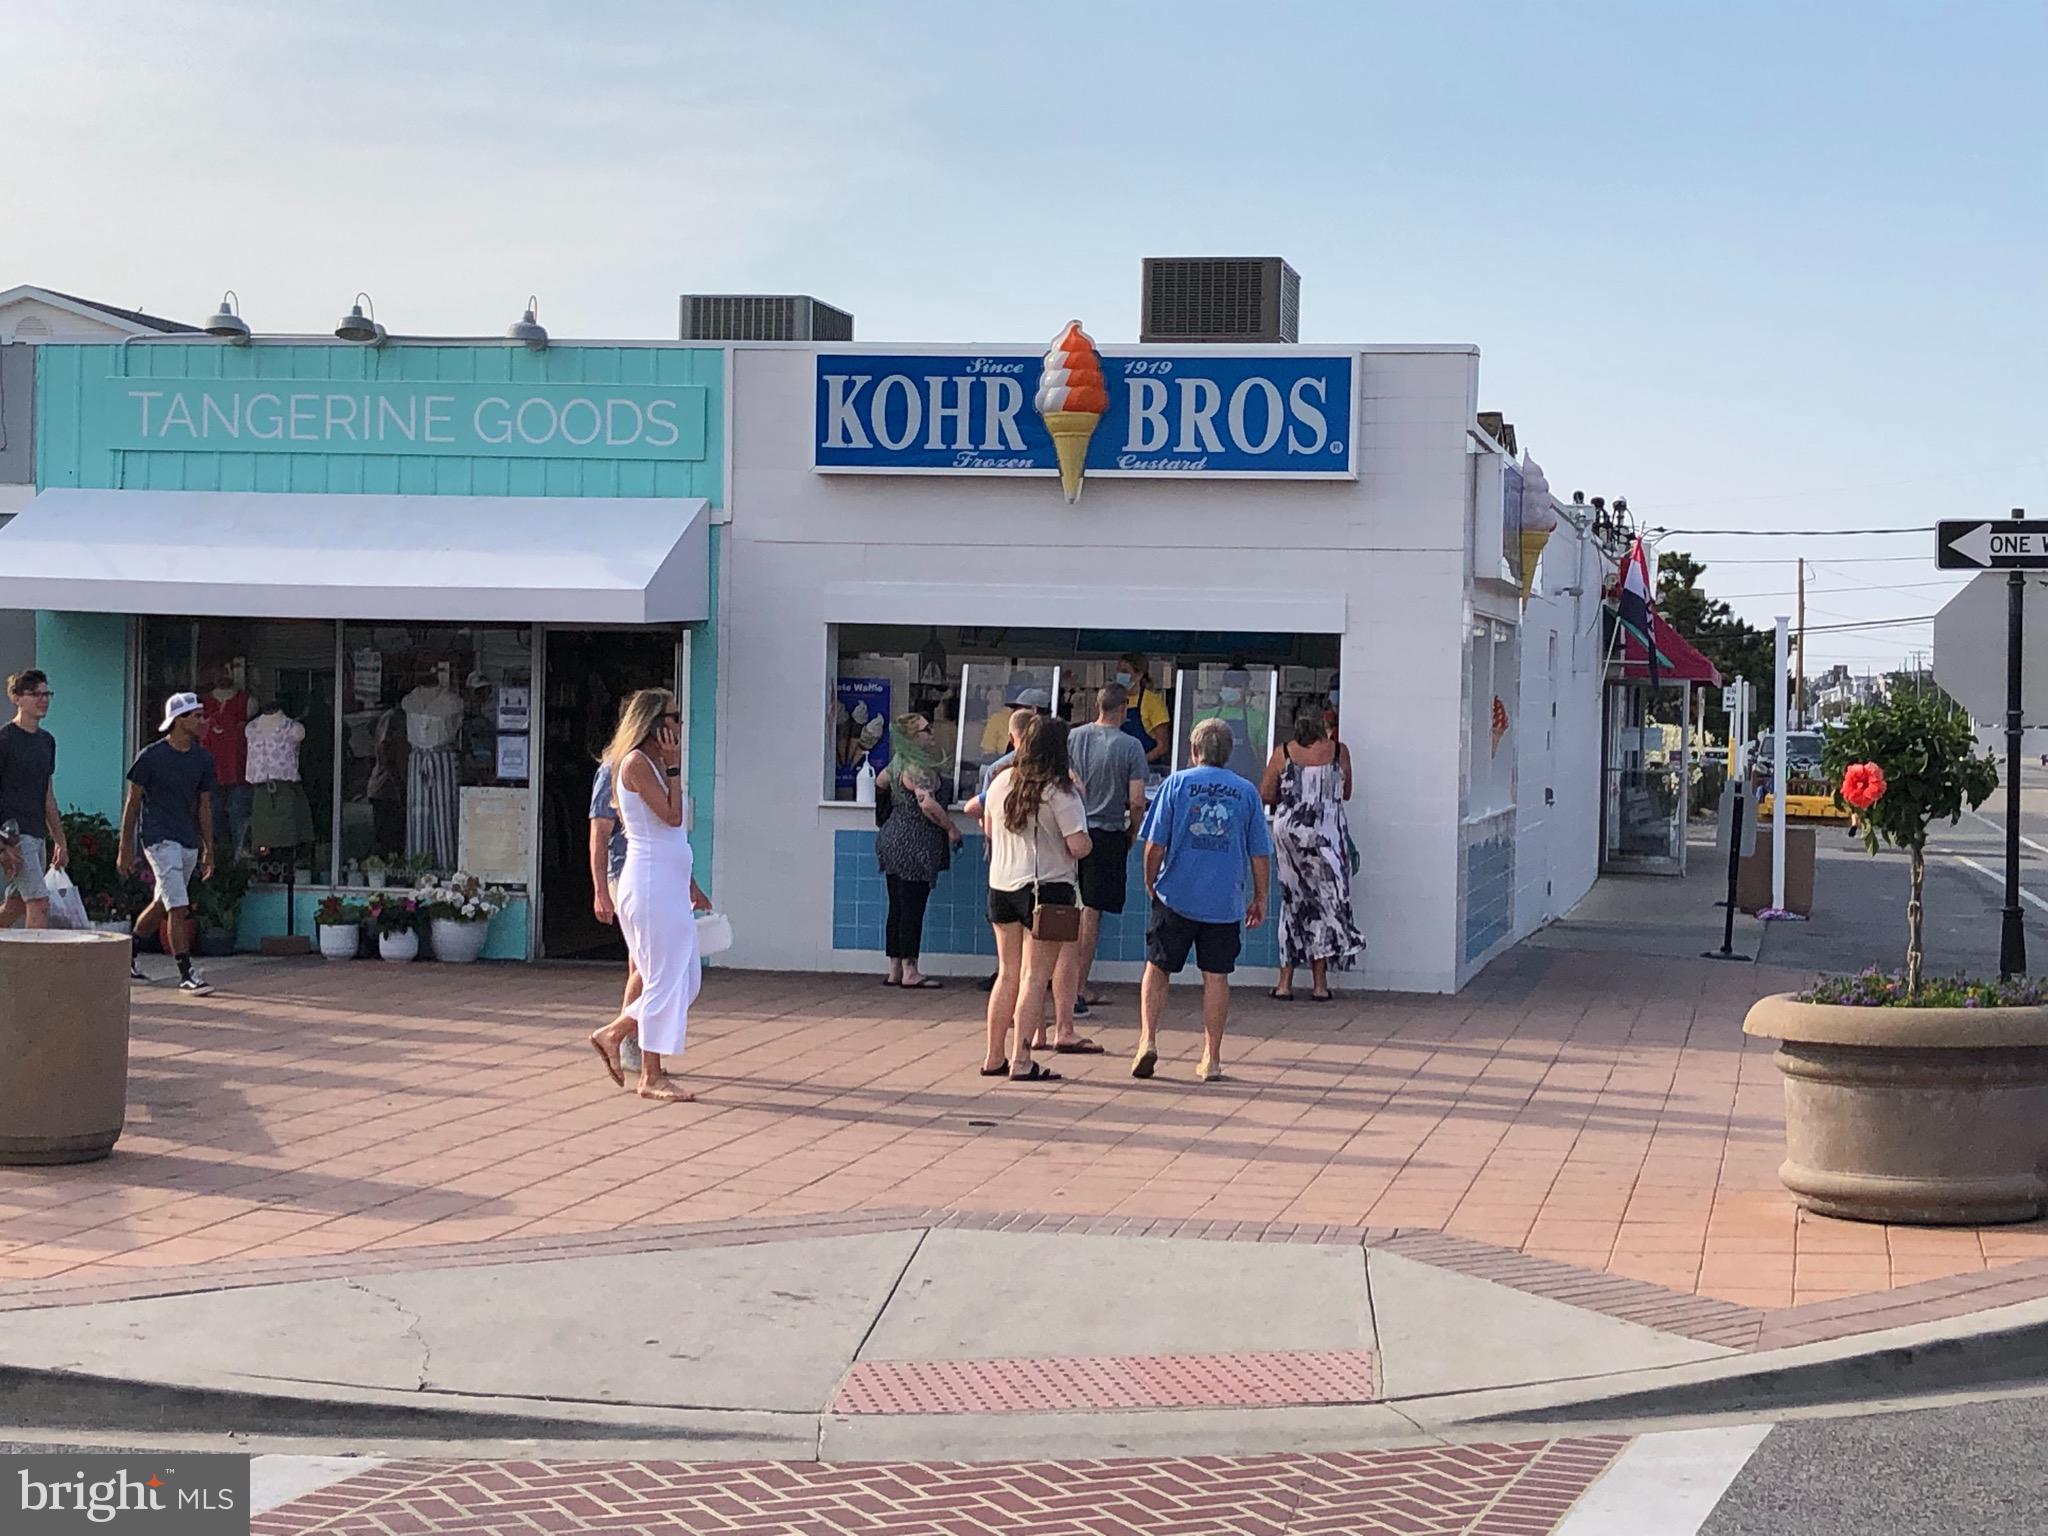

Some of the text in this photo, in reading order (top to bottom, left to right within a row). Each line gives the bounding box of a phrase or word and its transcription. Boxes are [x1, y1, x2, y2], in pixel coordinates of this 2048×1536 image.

[965, 358, 1173, 376] Since 1919
[127, 391, 680, 446] TANGERINE GOODS
[822, 374, 1028, 451] KOHR
[951, 450, 1208, 471] Frozen Custard
[1990, 536, 2031, 553] ONE
